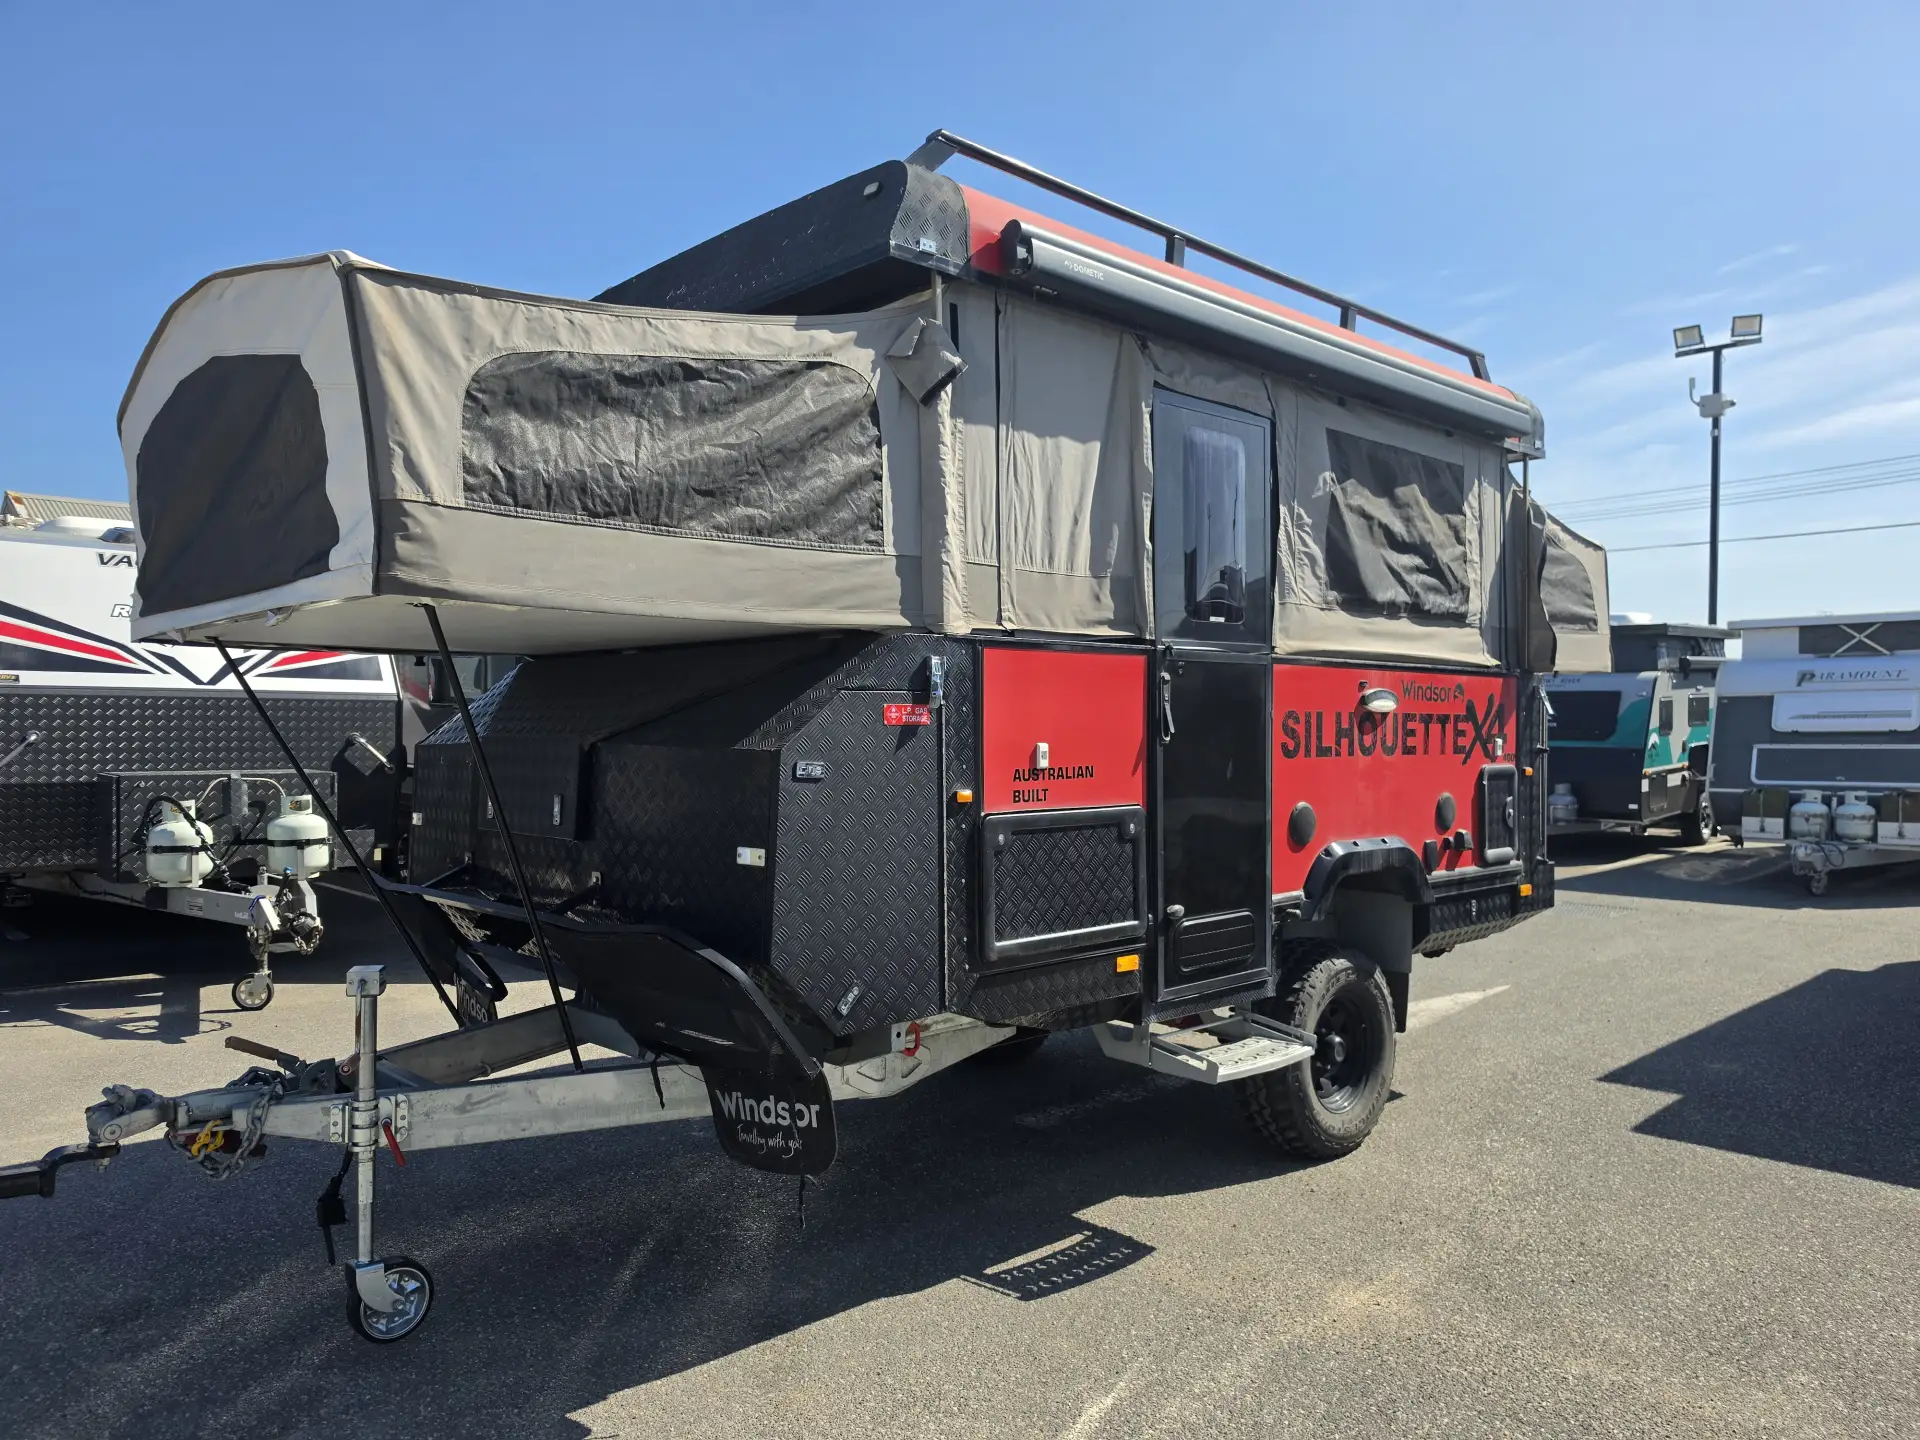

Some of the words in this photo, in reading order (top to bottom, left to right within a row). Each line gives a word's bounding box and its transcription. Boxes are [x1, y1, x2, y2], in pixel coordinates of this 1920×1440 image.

[1073, 264, 1104, 281] DOMETIC
[97, 553, 134, 568] VA
[110, 603, 133, 618] R
[1796, 669, 1908, 687] PARAMOUNT
[1402, 680, 1452, 703] Windsor
[1013, 765, 1095, 783] AUSTRALIAN
[1012, 788, 1049, 804] BUILT
[715, 1089, 820, 1129] Windsor
[737, 1124, 767, 1155] Travelling
[768, 1131, 786, 1149] with
